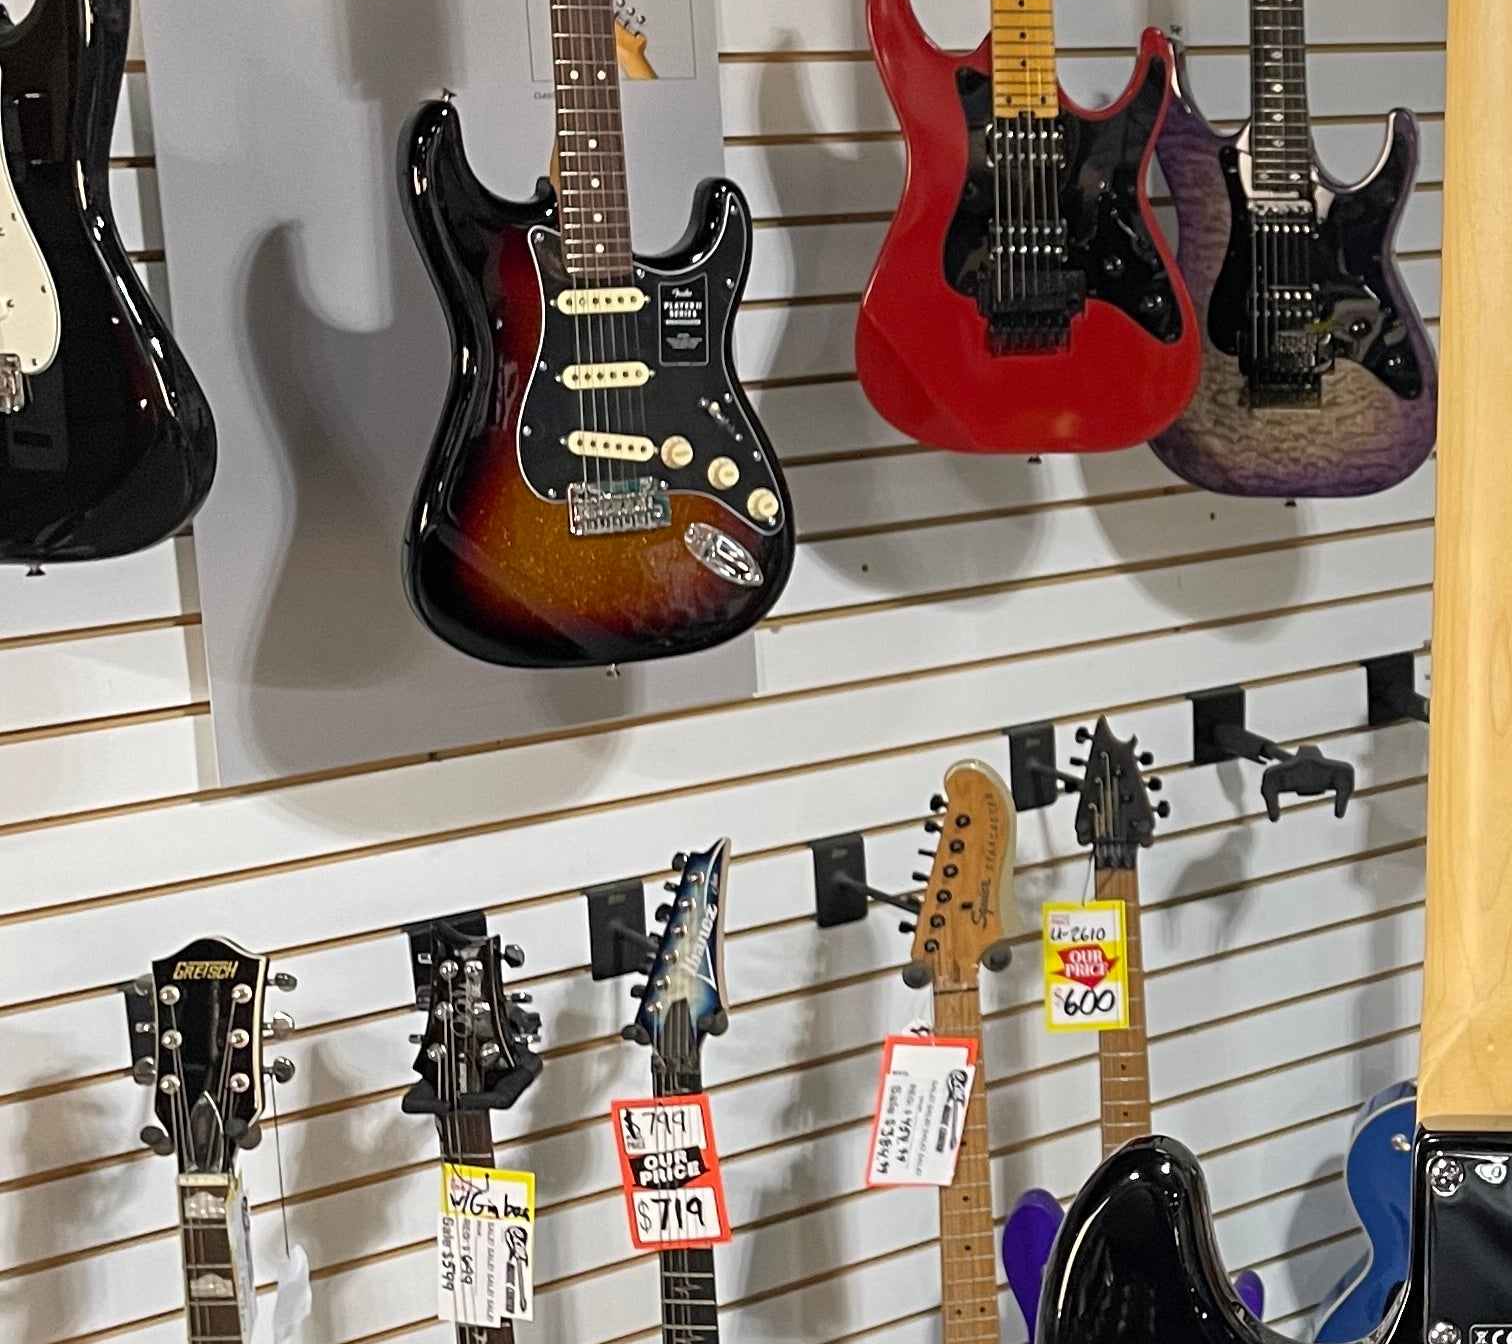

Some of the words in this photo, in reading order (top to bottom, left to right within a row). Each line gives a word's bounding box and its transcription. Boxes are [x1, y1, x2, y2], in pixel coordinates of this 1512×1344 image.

[1069, 949, 1103, 964] OUR
[173, 960, 238, 980] GRETSCH
[1065, 962, 1109, 978] PRICE
[644, 1150, 687, 1170] OUR
[639, 1161, 700, 1186] PRICE
